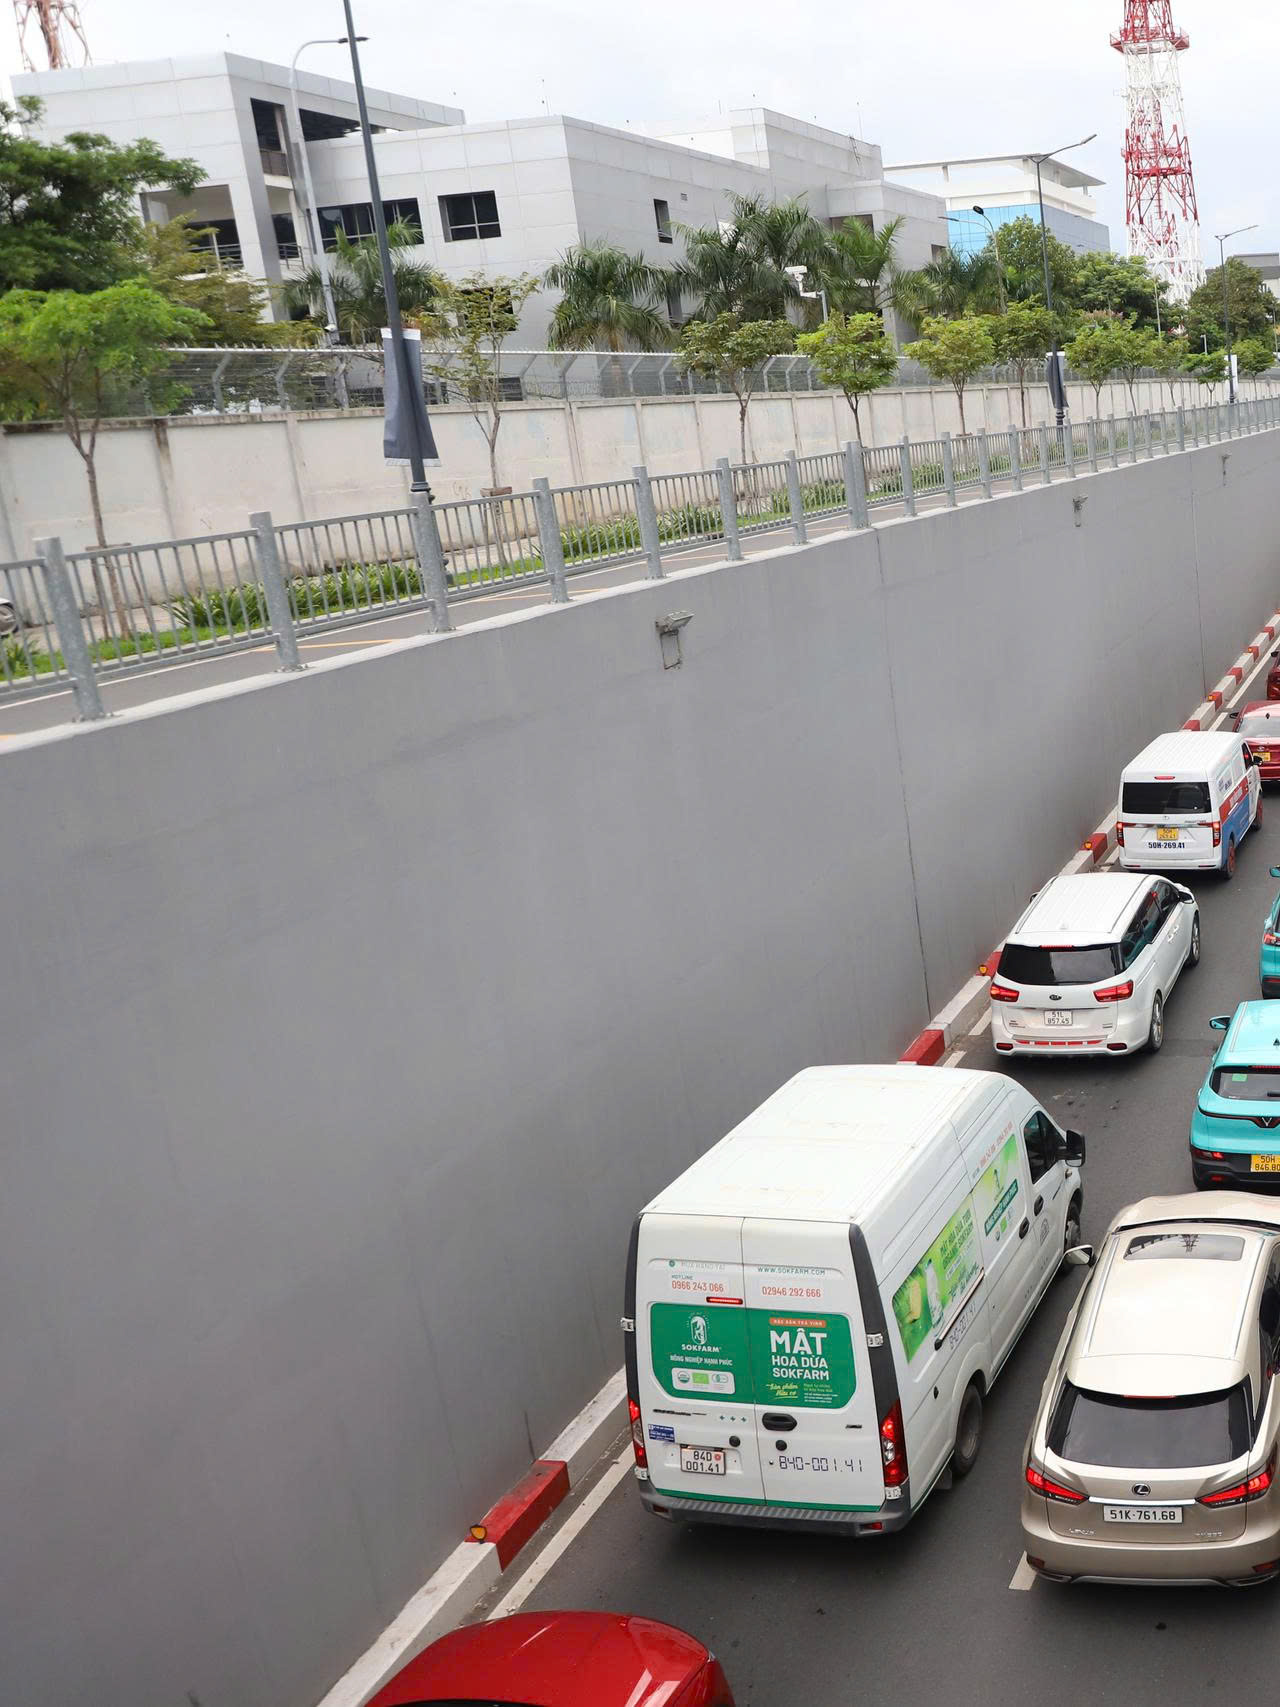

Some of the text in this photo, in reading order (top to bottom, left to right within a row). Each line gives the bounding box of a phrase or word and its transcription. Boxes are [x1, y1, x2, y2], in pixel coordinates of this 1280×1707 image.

[1260, 1155, 1276, 1163] 50H
[757, 1266, 826, 1276] WWW.SOKFARM.COM
[672, 1280, 724, 1293] 0966 243 066
[761, 1286, 822, 1298] 02946 292 666
[769, 1327, 828, 1356] MẬT
[681, 1343, 720, 1353] SOKFARM
[771, 1354, 829, 1369] HOA DỪA
[772, 1367, 830, 1381] SOKFARM
[693, 1452, 712, 1462] 84D
[686, 1462, 720, 1474] 001.41
